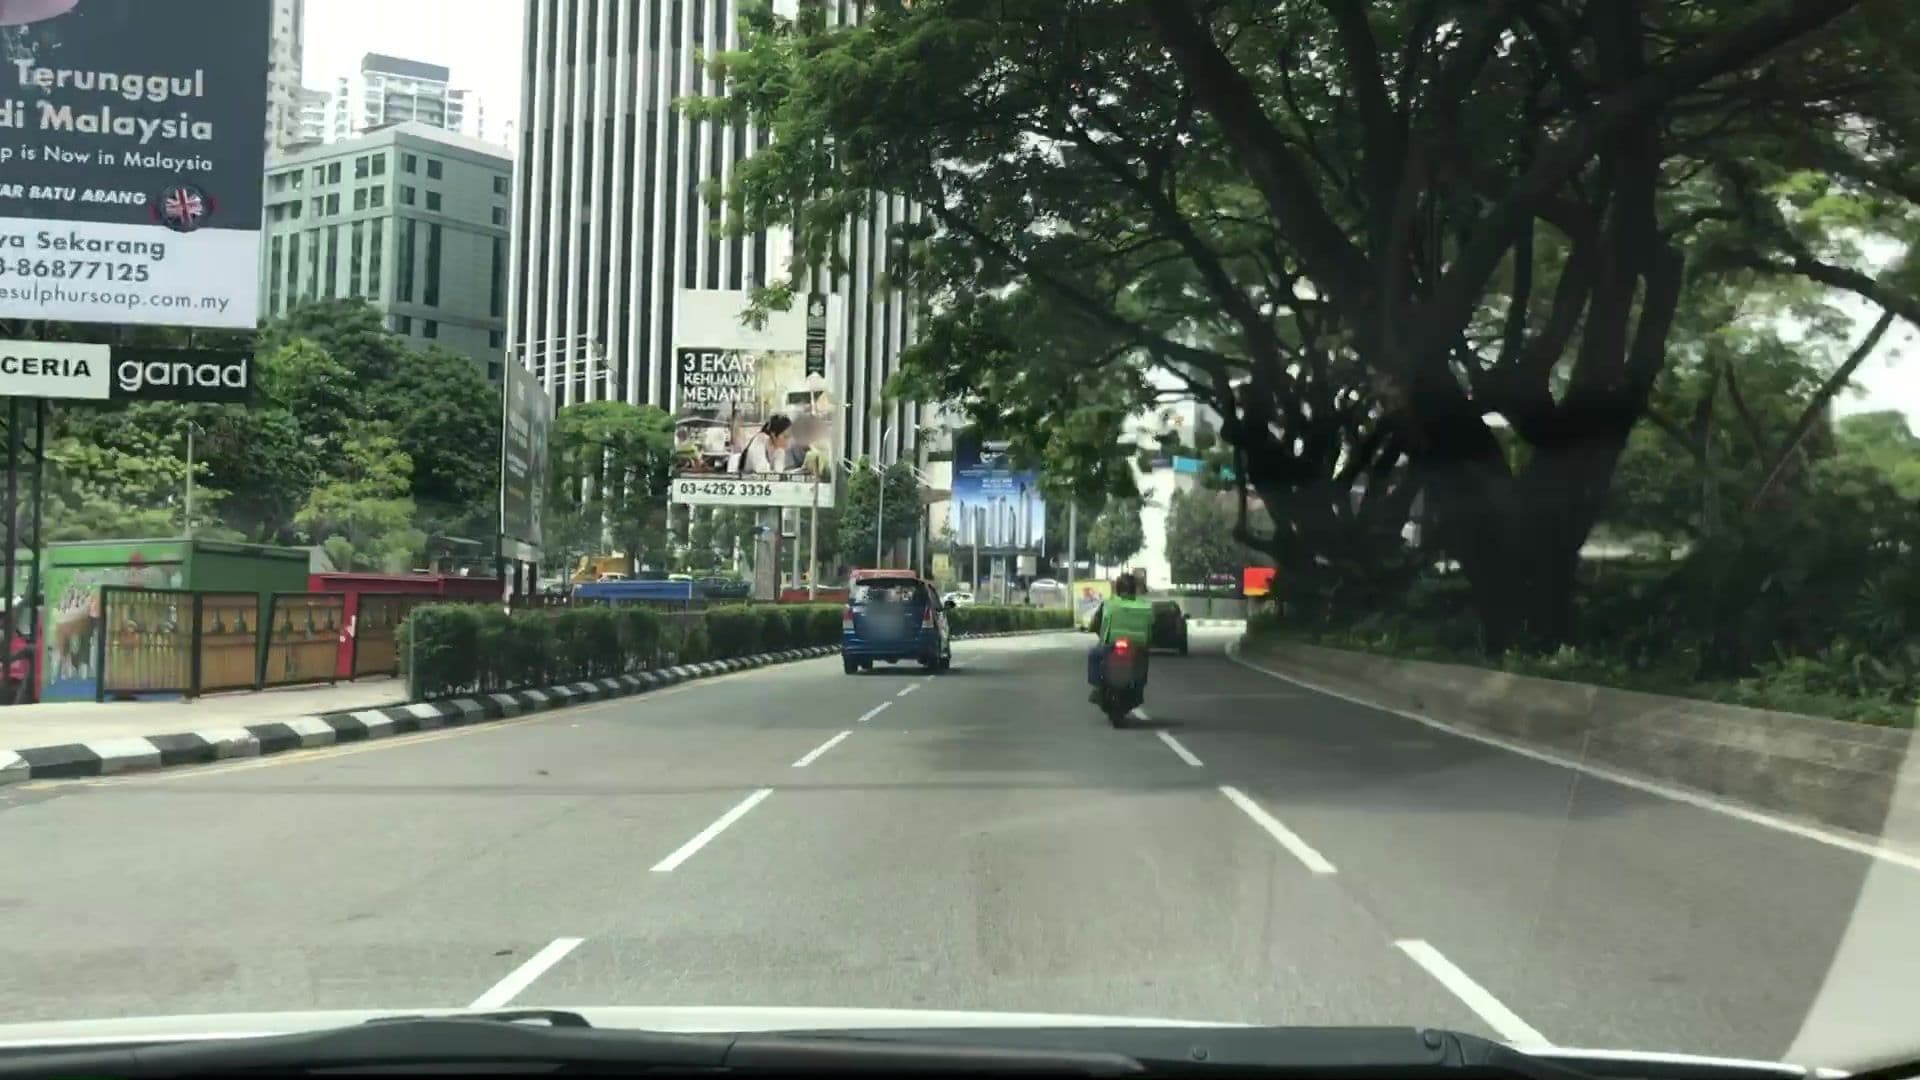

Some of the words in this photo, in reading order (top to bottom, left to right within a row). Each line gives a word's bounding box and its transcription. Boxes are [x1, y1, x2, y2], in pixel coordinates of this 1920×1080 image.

[14, 58, 203, 102] Terunggul
[37, 100, 213, 144] Malaysia
[21, 143, 36, 161] is
[44, 145, 90, 164] Now
[98, 150, 114, 165] in
[124, 151, 213, 173] Malaysia
[29, 185, 76, 201] BATU
[80, 188, 147, 204] ARANG
[37, 231, 166, 261] Sekarang
[1, 356, 91, 377] CERIA
[684, 352, 696, 372] 3
[701, 353, 755, 373] EKAR
[118, 359, 247, 392] ganad
[683, 386, 756, 402] MENANTI
[680, 482, 736, 496] 03-4252
[740, 484, 772, 497] 3336
